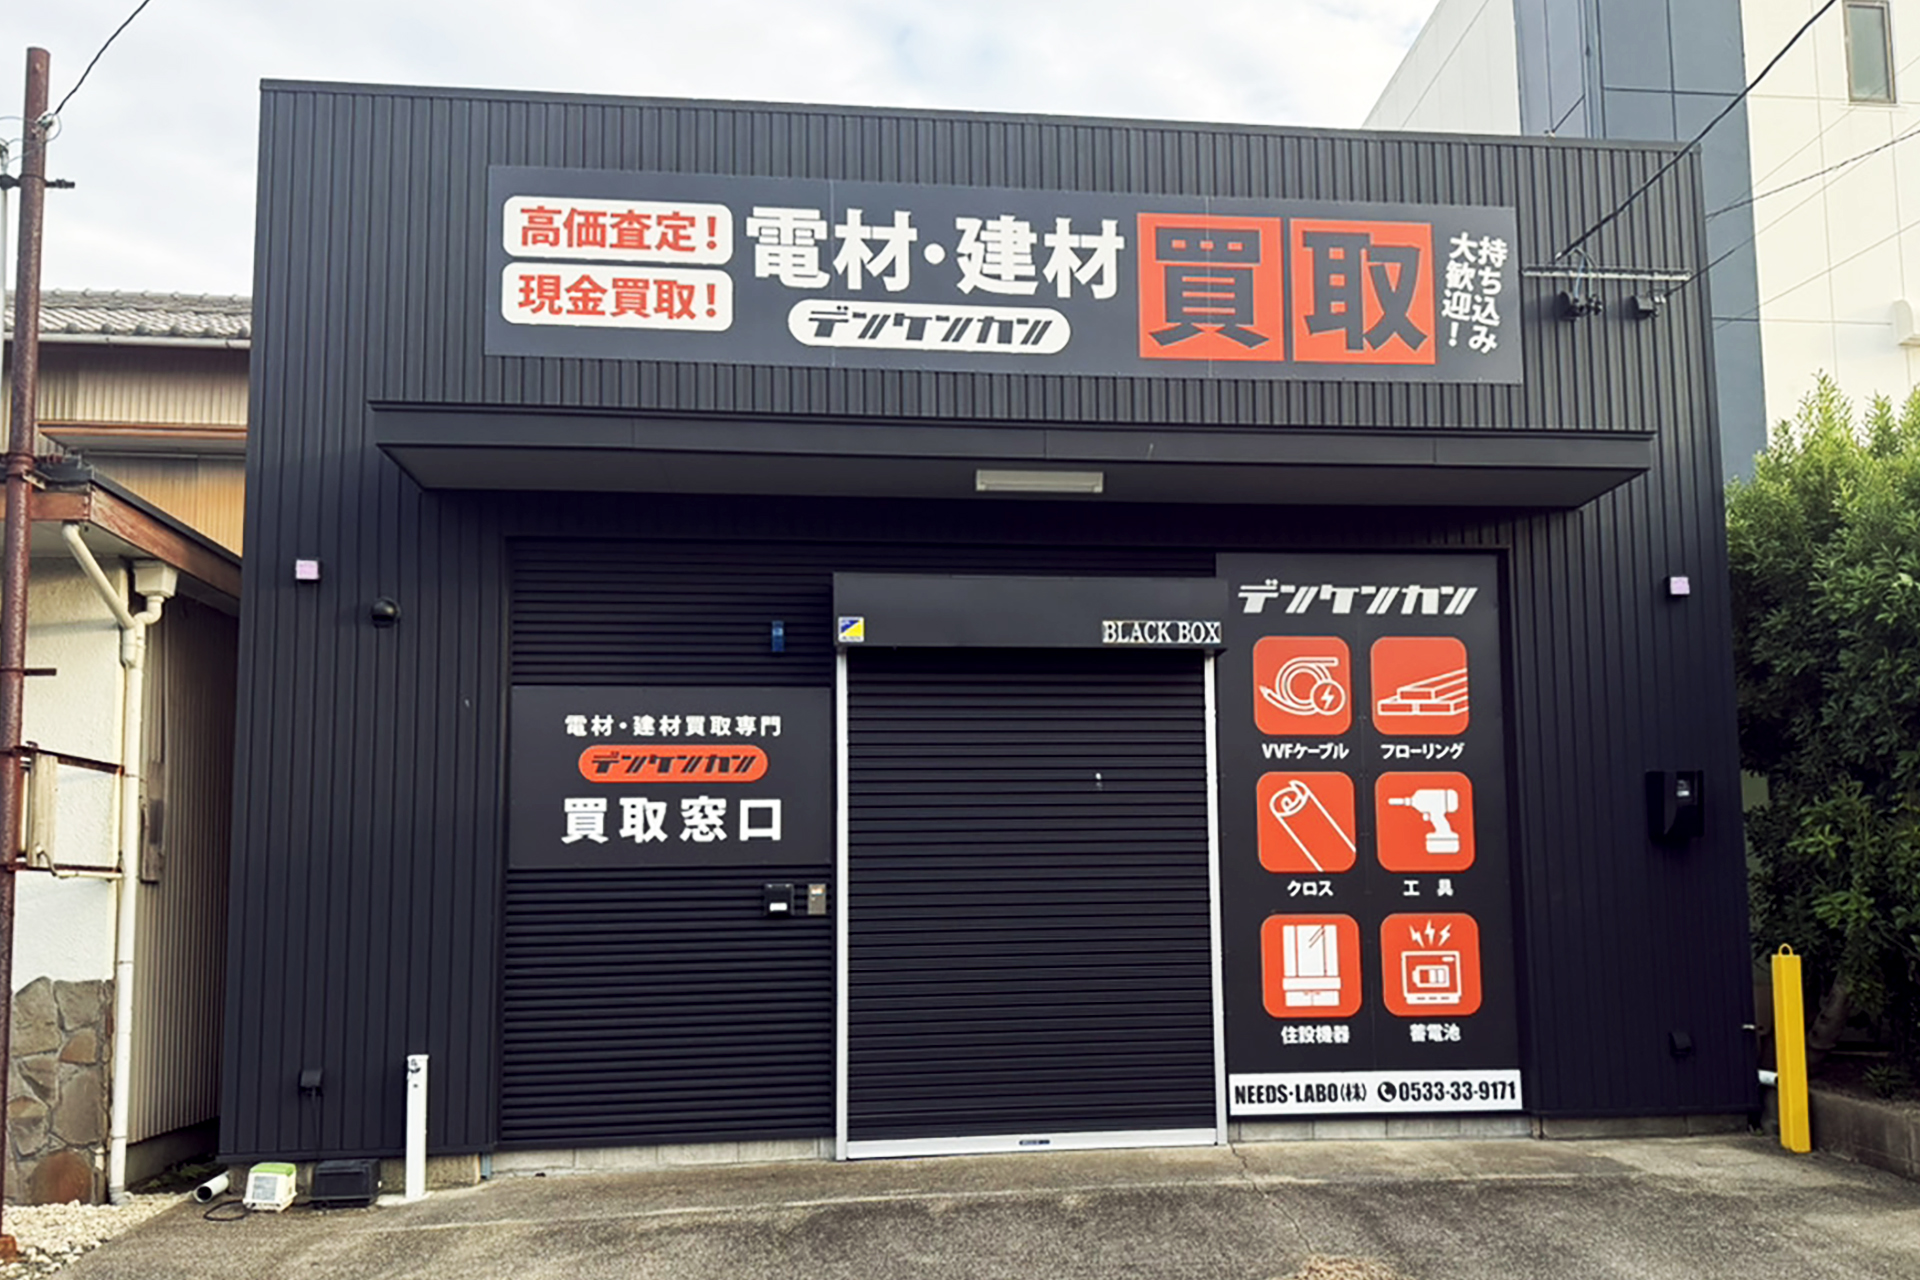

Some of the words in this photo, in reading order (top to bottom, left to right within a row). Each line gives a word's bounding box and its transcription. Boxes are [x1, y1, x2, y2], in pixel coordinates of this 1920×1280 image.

[519, 205, 718, 253] 高価査定！
[517, 273, 718, 320] 現金買取！
[808, 305, 1053, 346] デンケンカン
[1238, 579, 1478, 615] デンケンカン
[1102, 620, 1172, 643] BLACK
[1178, 621, 1221, 643] BOX
[591, 751, 757, 774] デンケンカン
[1262, 743, 1349, 759] VVFケーブル
[1380, 742, 1465, 760] フローリング
[561, 795, 782, 844] 買取窓口
[1287, 880, 1334, 897] クロス
[1281, 1025, 1350, 1045] 住設機器
[1410, 1024, 1461, 1042] 蓄電池
[1398, 1080, 1516, 1101] 0533-33-9171
